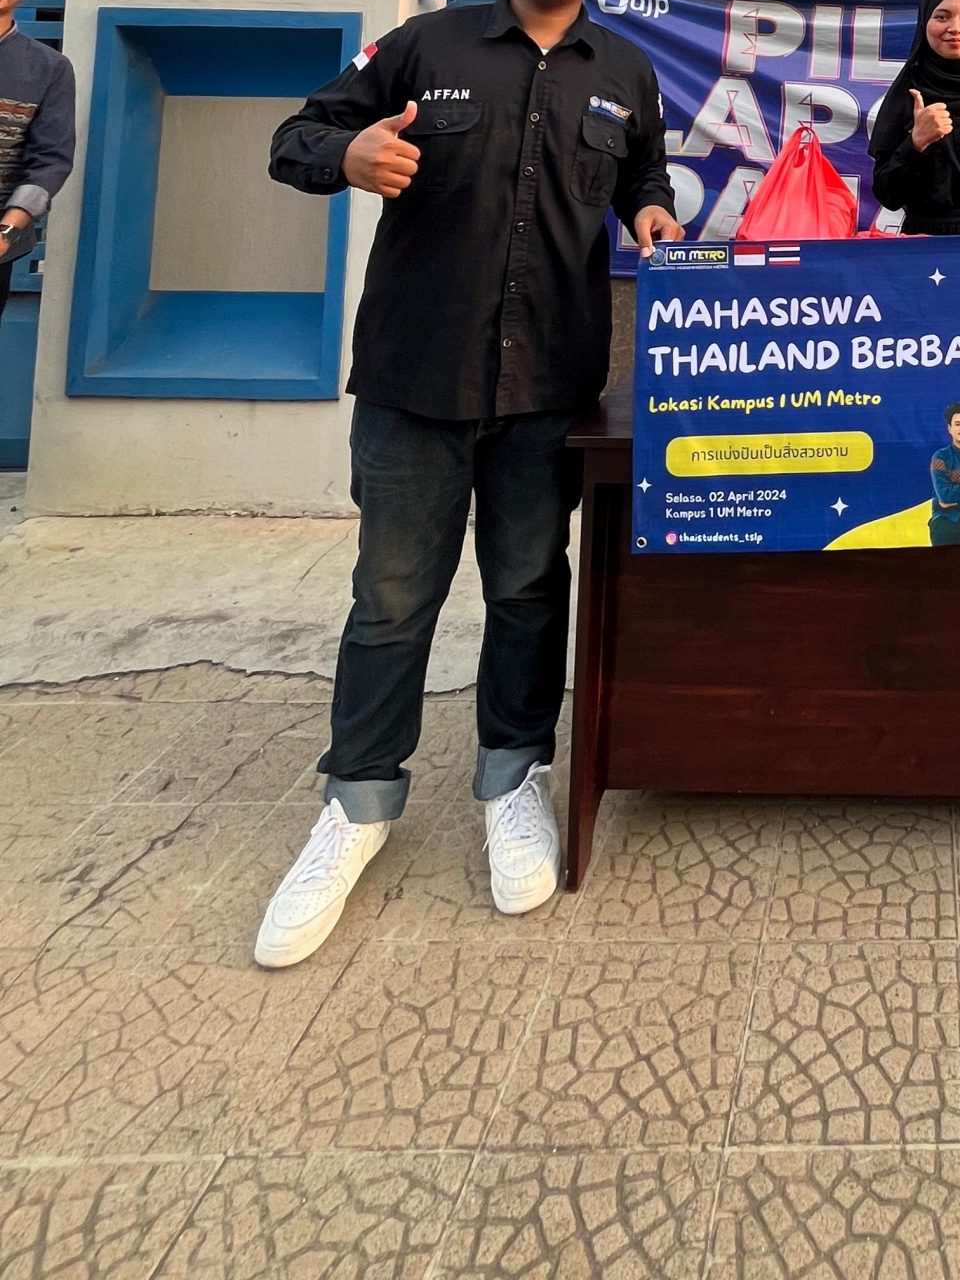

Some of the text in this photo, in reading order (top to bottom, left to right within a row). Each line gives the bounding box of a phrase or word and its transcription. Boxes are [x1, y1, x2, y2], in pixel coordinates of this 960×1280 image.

[421, 88, 471, 102] AFFAN
[688, 249, 726, 261] METRO
[648, 294, 882, 331] MAHASISWA
[647, 339, 840, 377] THAILAND
[649, 396, 702, 413] Lokasi
[707, 394, 774, 414] Kampus
[791, 390, 822, 407] UM
[827, 389, 882, 407] Metro
[691, 442, 849, 462] การแบ่งปันเป็นสิ่งสวยงาม
[709, 491, 724, 502] 02
[728, 490, 754, 504] April
[756, 489, 787, 501] 2024
[665, 508, 706, 521] Kampus
[717, 506, 734, 517] UM
[736, 506, 772, 517] Metro
[678, 532, 763, 544] thaistudents_tslp
